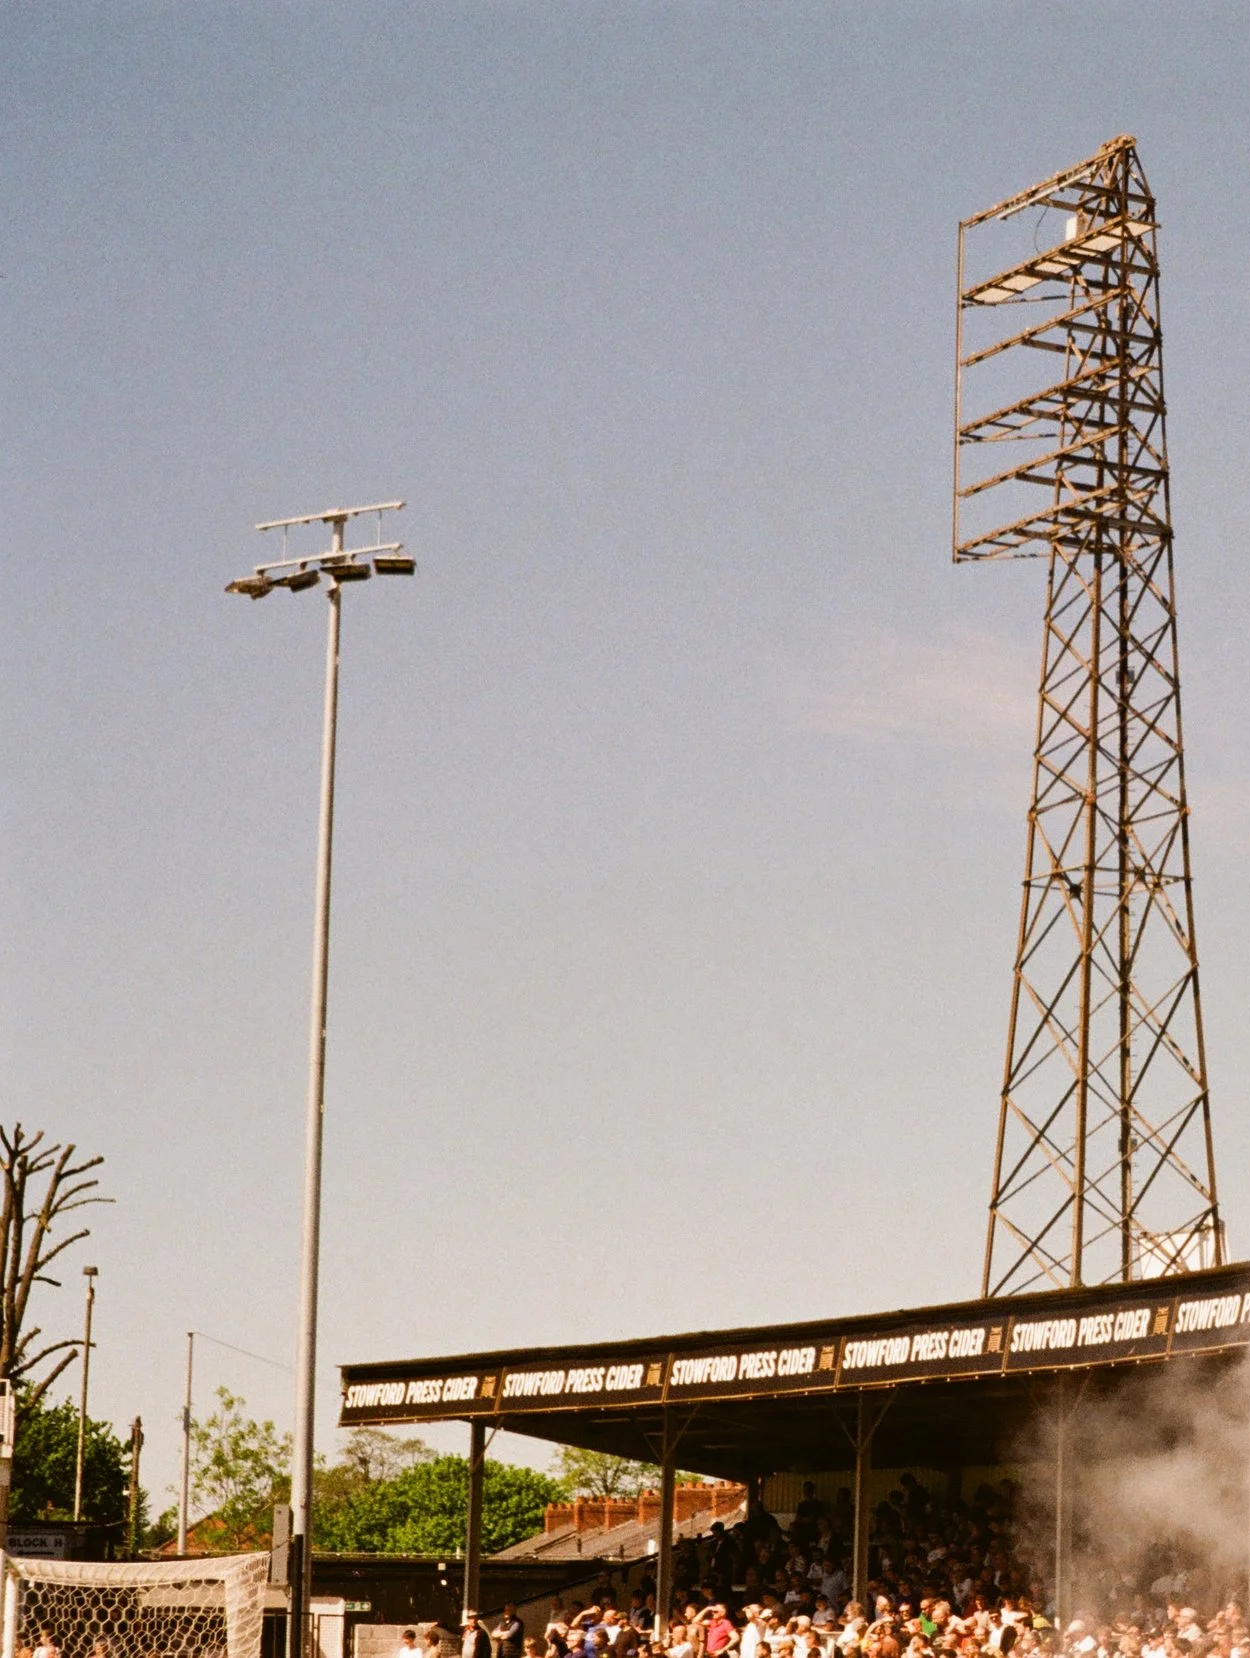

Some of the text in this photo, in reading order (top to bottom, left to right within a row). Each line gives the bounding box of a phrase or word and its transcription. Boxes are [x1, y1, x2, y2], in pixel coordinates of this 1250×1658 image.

[1010, 1308, 1150, 1352] STOWFORD PRESS CIDER
[1175, 1294, 1241, 1334] STOWFORD
[670, 1346, 816, 1386] STOWFORD PRESS CIDER
[842, 1328, 985, 1369] STOWFORD PRESS CIDER
[345, 1376, 478, 1408] STOWFORD PRESS CIDER
[502, 1364, 644, 1398] STOWFORD PRESS CIDER
[8, 1537, 48, 1547] BLOCK
